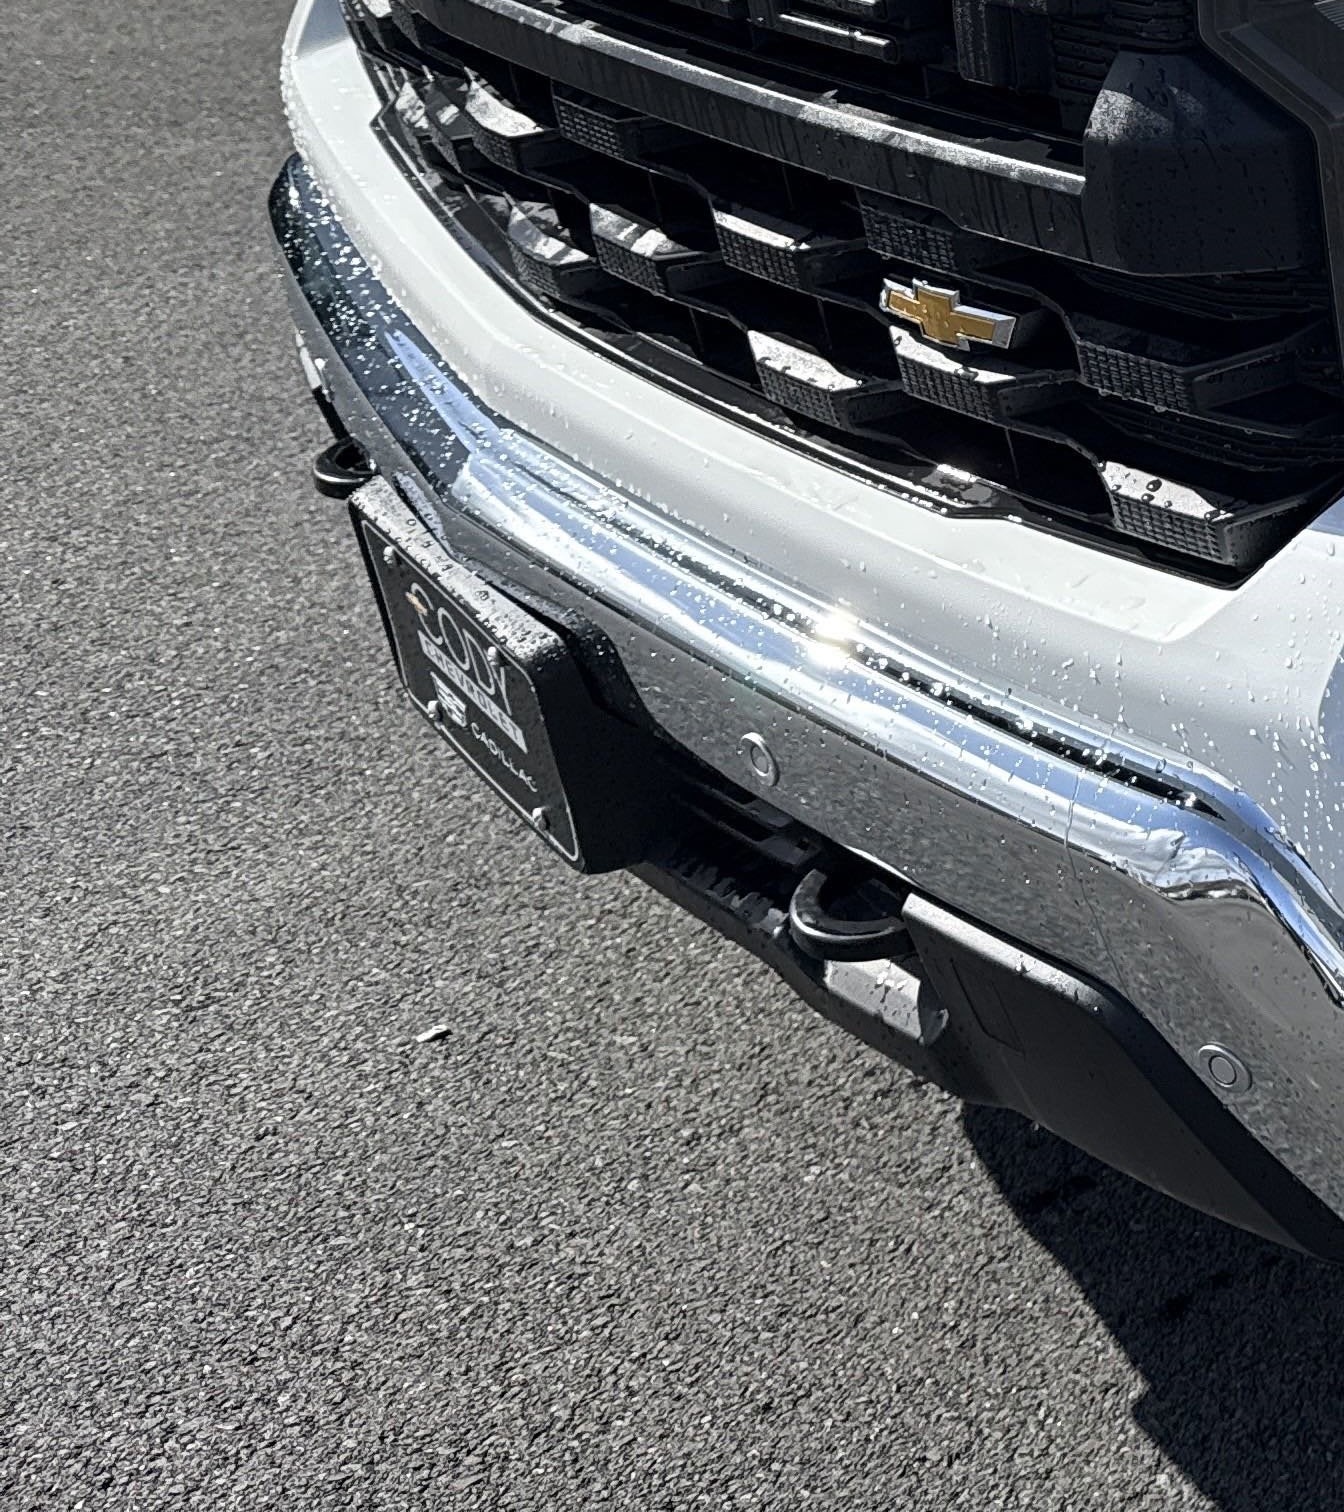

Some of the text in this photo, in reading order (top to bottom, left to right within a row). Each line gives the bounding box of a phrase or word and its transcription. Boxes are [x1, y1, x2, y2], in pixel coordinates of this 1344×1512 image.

[407, 580, 515, 718] CODY
[424, 637, 521, 746] CHEVROLET
[471, 722, 538, 793] CADILLAC
